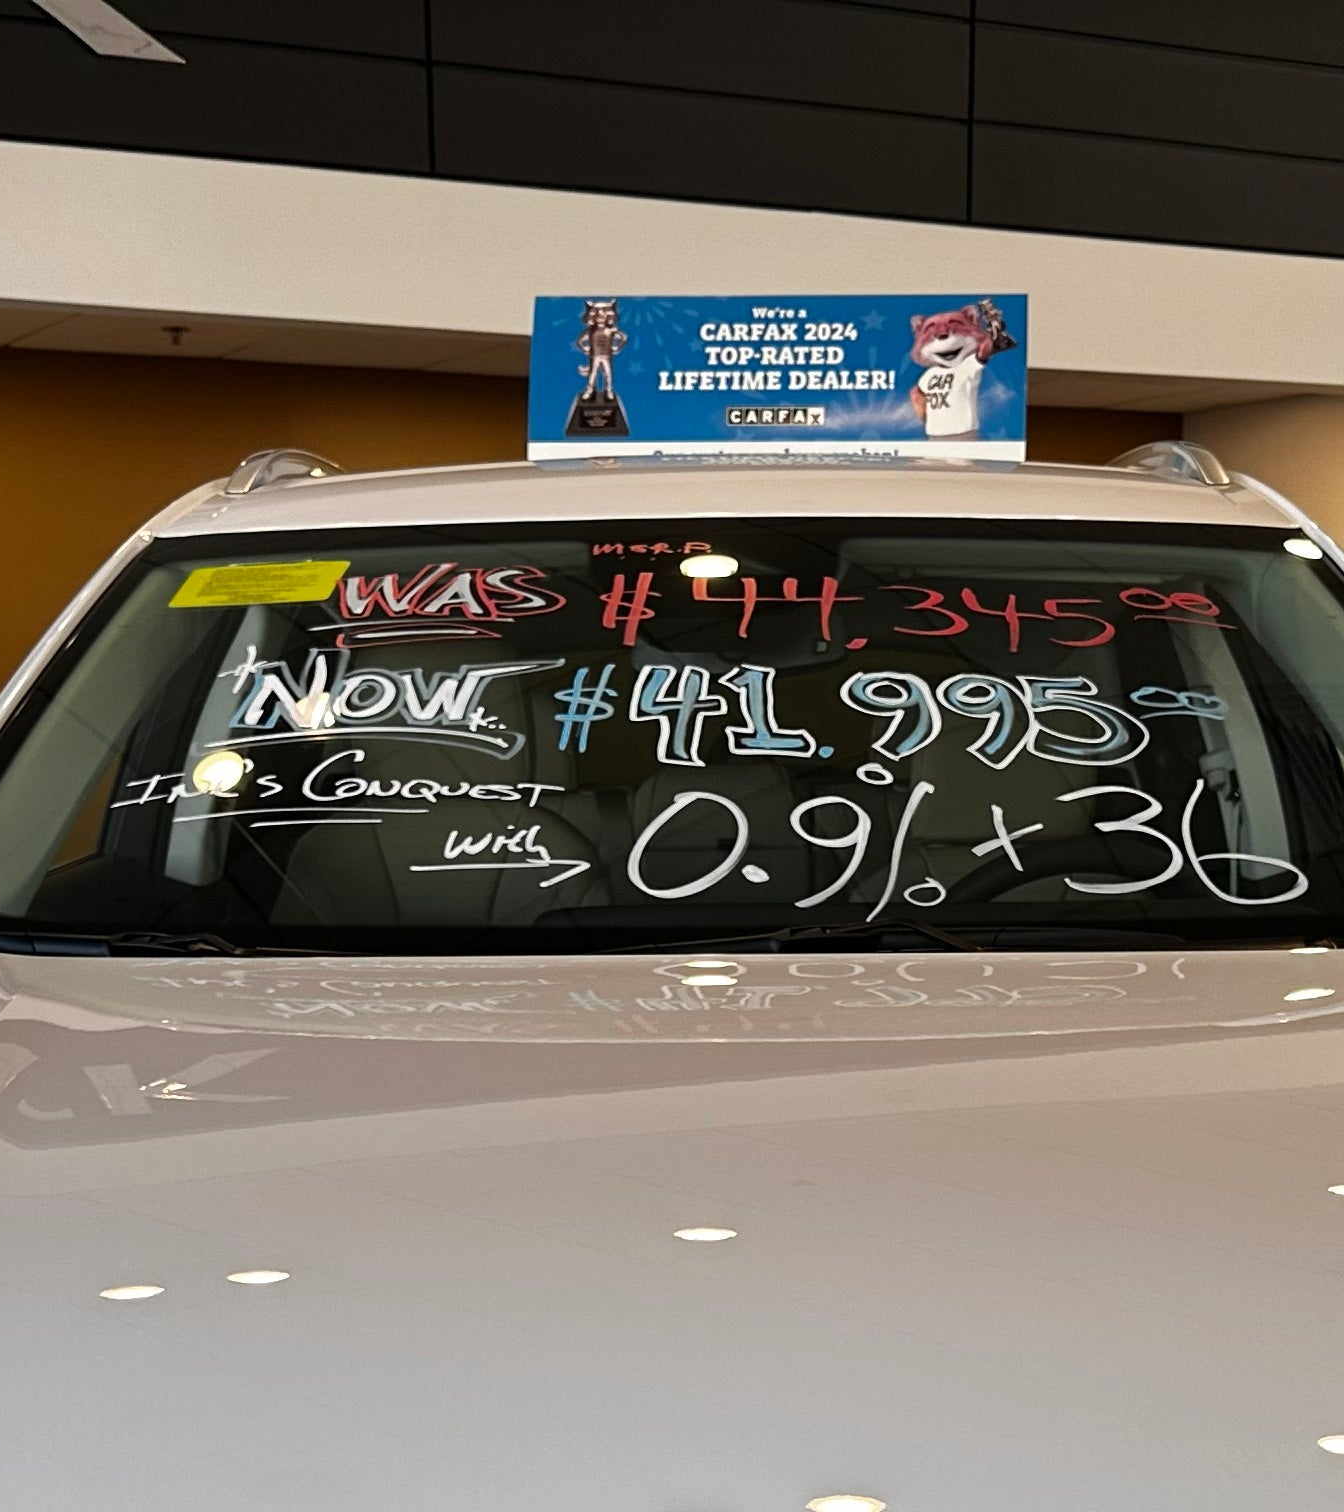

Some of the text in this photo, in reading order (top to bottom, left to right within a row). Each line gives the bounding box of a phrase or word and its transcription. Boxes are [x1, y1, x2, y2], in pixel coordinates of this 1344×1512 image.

[752, 306, 808, 320] We're a
[700, 322, 858, 343] CARFAX 2024
[705, 345, 845, 366] TOP-RATED
[658, 369, 896, 392] LIFETIME DEALER!
[728, 408, 824, 425] CARFAX
[339, 563, 566, 620] WAS
[1055, 779, 1309, 905] 36
